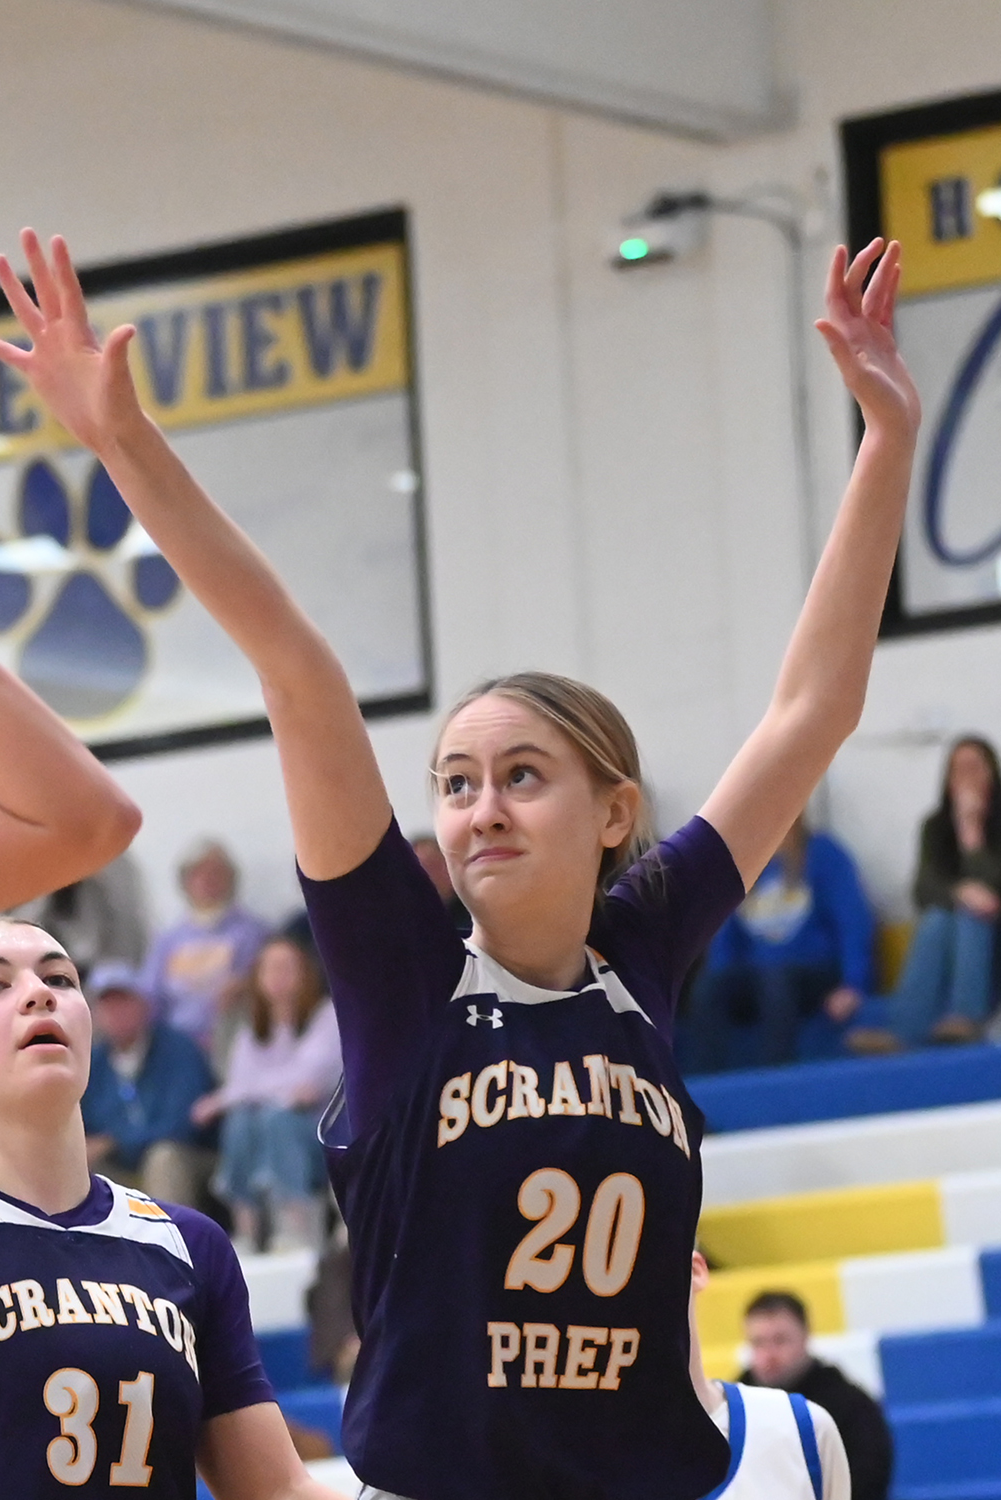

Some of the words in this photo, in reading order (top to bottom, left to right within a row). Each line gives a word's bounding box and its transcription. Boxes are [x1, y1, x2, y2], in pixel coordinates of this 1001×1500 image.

[436, 1053, 692, 1161] SCRANTON
[503, 1166, 646, 1297] 20
[486, 1320, 641, 1391] PREP
[42, 1366, 155, 1487] 31
